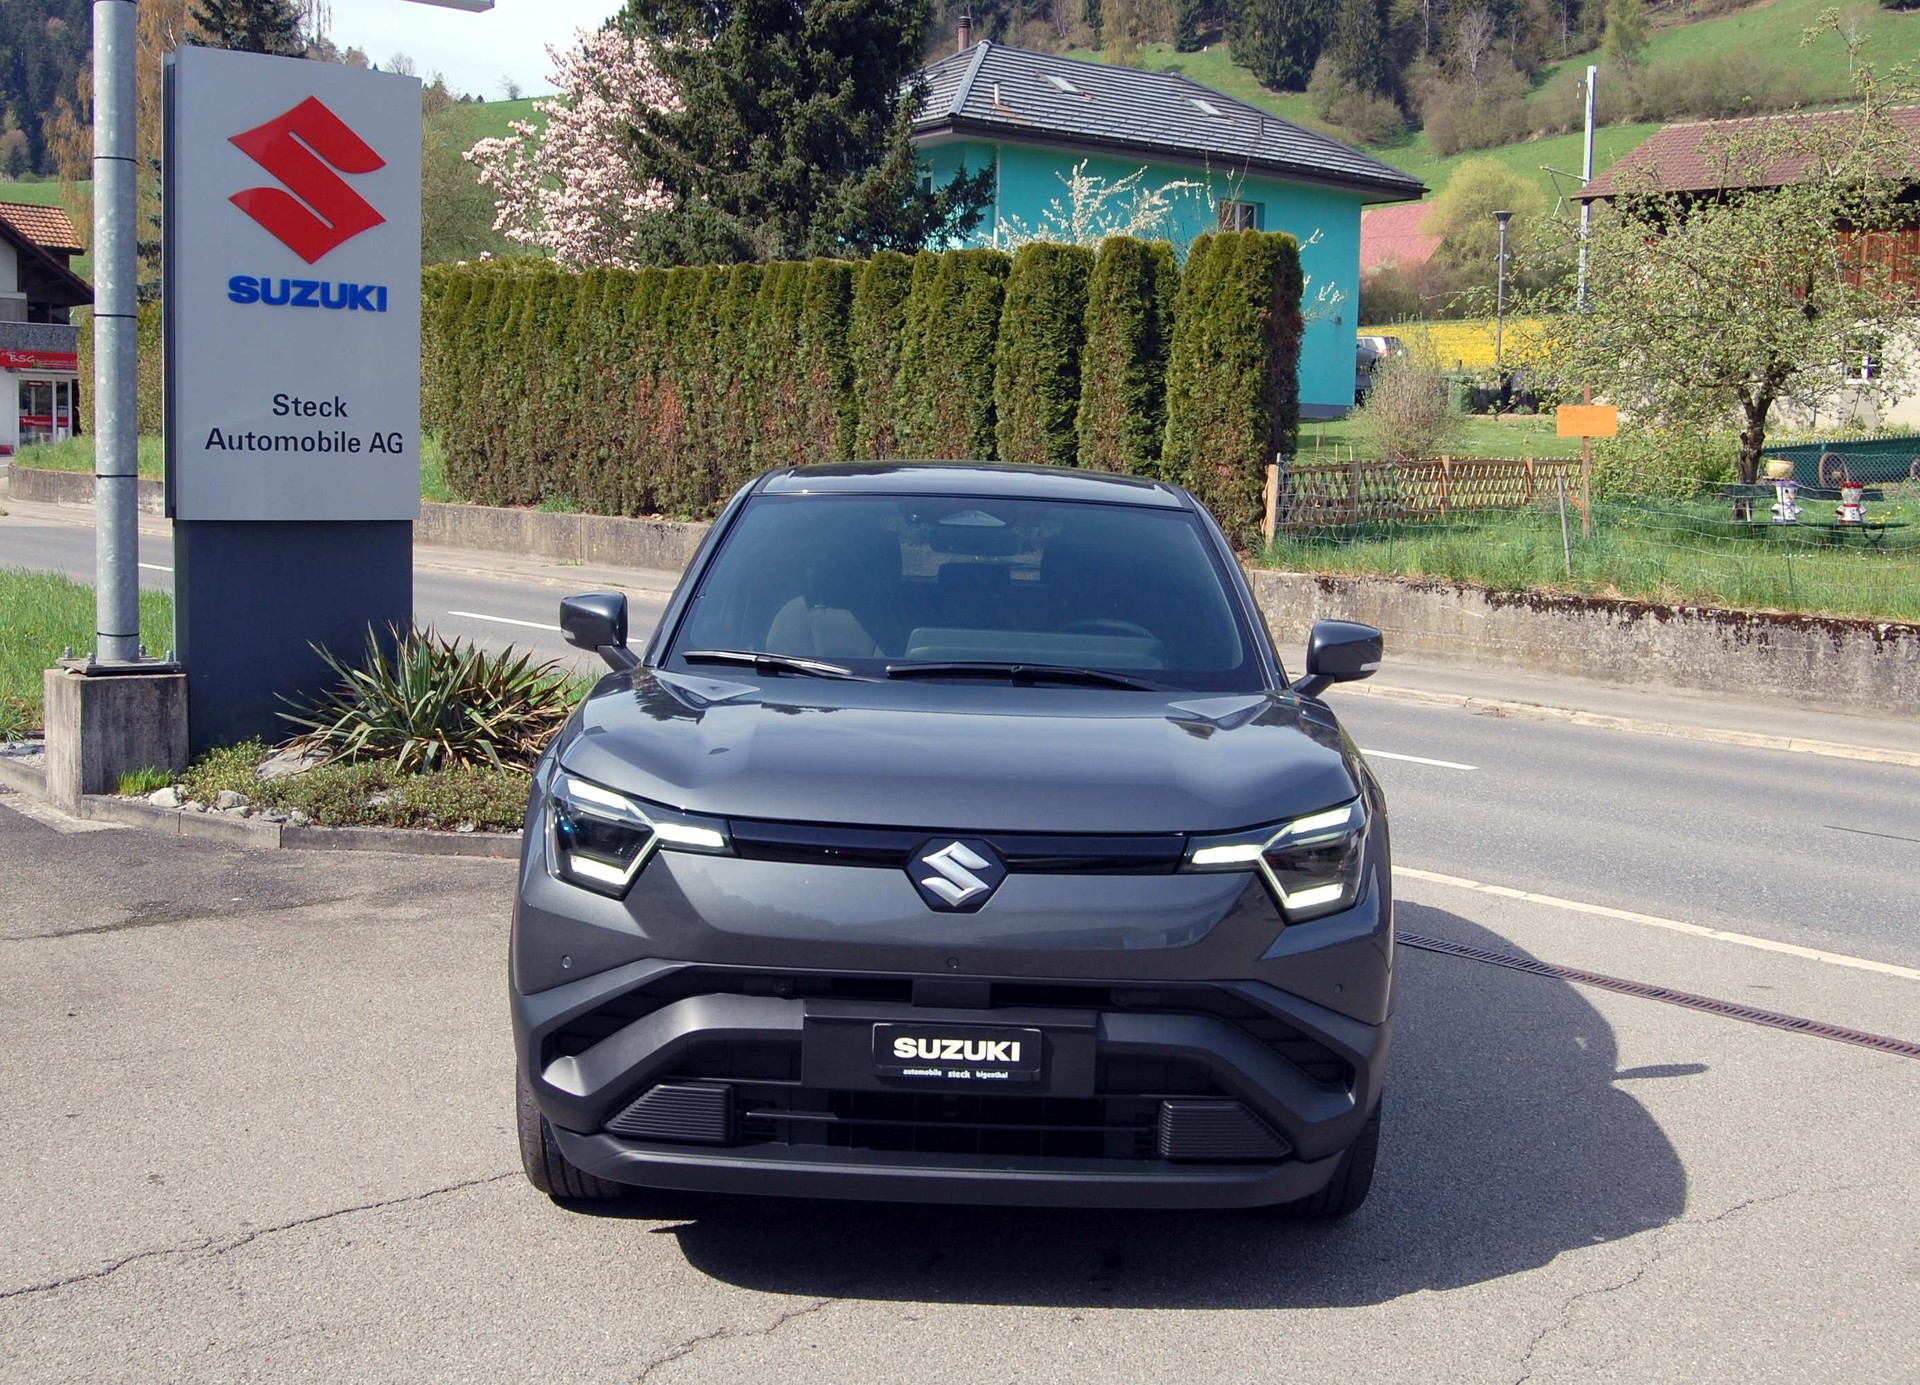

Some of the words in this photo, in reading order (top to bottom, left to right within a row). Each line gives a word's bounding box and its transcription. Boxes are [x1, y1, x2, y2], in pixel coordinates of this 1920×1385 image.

[227, 275, 387, 312] SUZUKI
[9, 353, 35, 364] BSG
[272, 393, 348, 418] Steck
[205, 428, 361, 453] Automobile
[368, 432, 404, 454] AG
[893, 1037, 1021, 1062] SUZUKI
[903, 1068, 942, 1076] automobile
[947, 1070, 971, 1078] steck
[975, 1070, 1008, 1079] bigenthal
